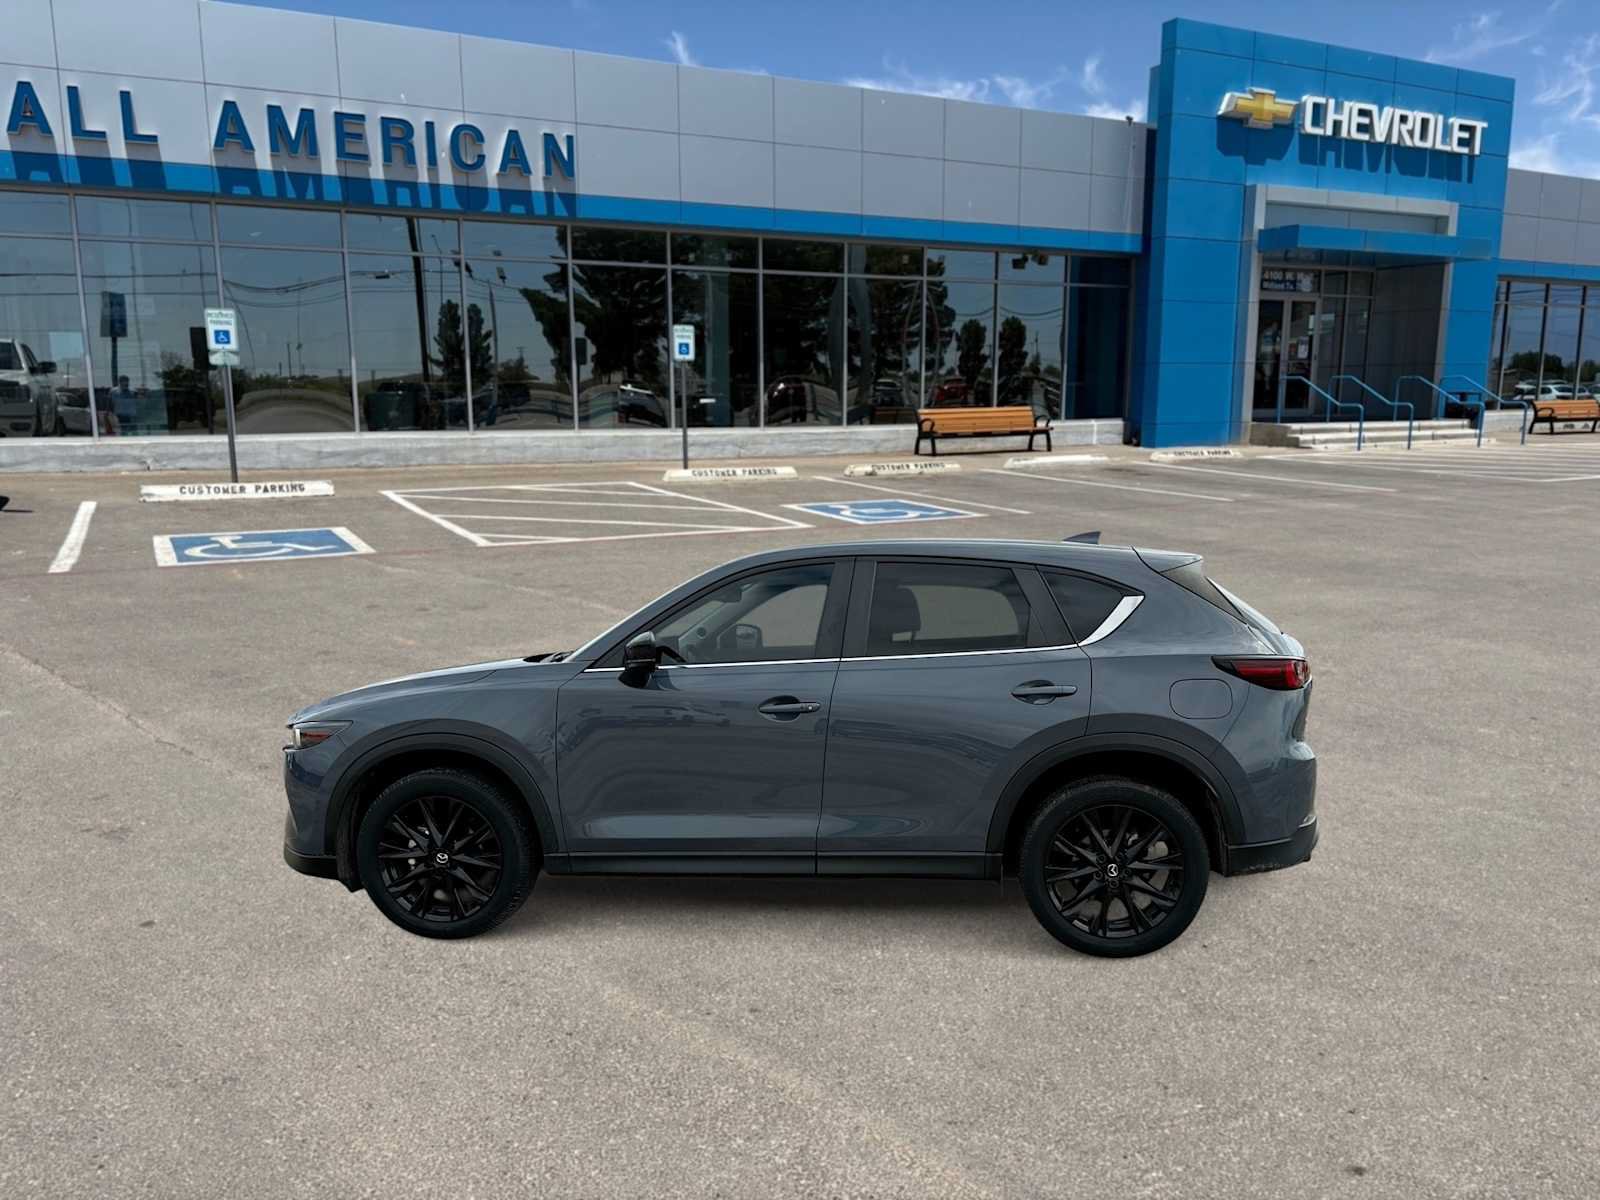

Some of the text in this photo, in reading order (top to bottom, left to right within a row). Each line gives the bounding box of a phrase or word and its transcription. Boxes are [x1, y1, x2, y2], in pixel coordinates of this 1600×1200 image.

[7, 80, 576, 178] ALL AMERICAN
[1301, 94, 1488, 156] CHEVROLET
[179, 482, 306, 496] CUSTOMER PARKING
[691, 469, 738, 477] CUSTOMER
